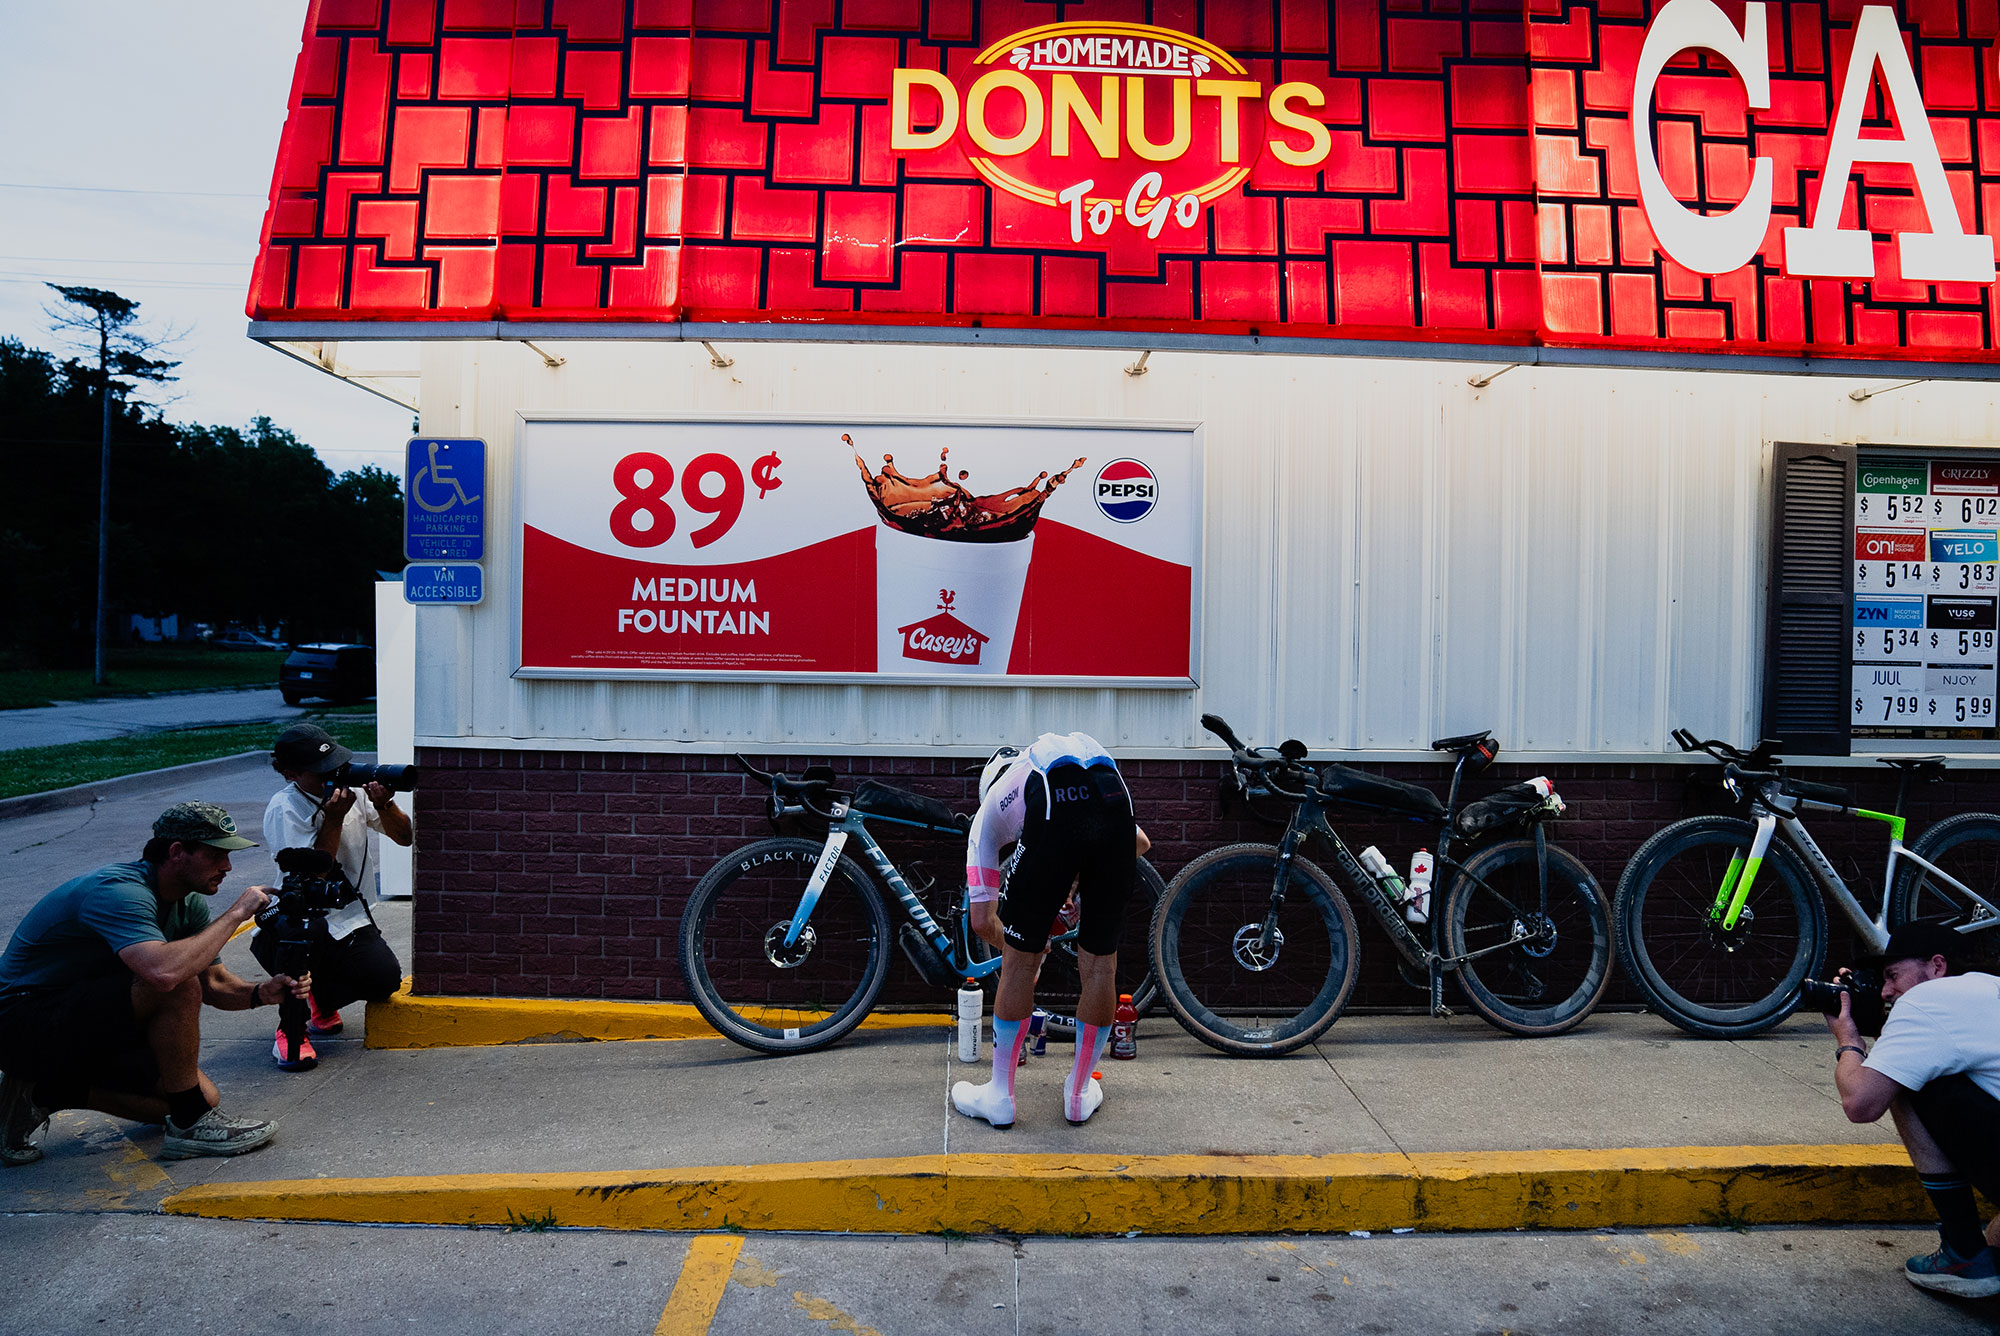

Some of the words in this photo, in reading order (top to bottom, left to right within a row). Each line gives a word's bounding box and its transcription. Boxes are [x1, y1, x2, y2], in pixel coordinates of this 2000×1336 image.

[1033, 37, 1189, 69] HOMEMADE
[891, 68, 1332, 166] DONUTS
[1058, 179, 1115, 243] To
[1125, 171, 1200, 240] Go
[1862, 472, 1920, 490] Copenhagen
[1941, 468, 1991, 480] GRIZZLY
[1098, 483, 1154, 498] PEPSI
[413, 514, 478, 523] HANDICAPPED
[425, 524, 465, 533] PARKING
[419, 538, 457, 547] VEHICLE
[462, 539, 472, 547] ID
[1943, 542, 1984, 556] VELO
[434, 570, 455, 582] VAN
[411, 586, 477, 598] ACCESSIBLE
[631, 577, 757, 603] MEDIUM
[618, 609, 769, 635] FOUNTAIN
[1857, 607, 1888, 620] ZYN
[909, 628, 977, 658] Casey's
[1872, 671, 1901, 685] JUUL
[1943, 675, 1977, 685] NJOY
[1054, 785, 1090, 803] RCC
[740, 851, 794, 871] BLACK
[802, 852, 821, 865] IN
[819, 845, 841, 883] FACTOR
[1796, 830, 1839, 881] SCOTT
[864, 846, 939, 936] FACTOR
[1336, 850, 1408, 937] cannondale
[192, 1129, 228, 1141] HOKA
